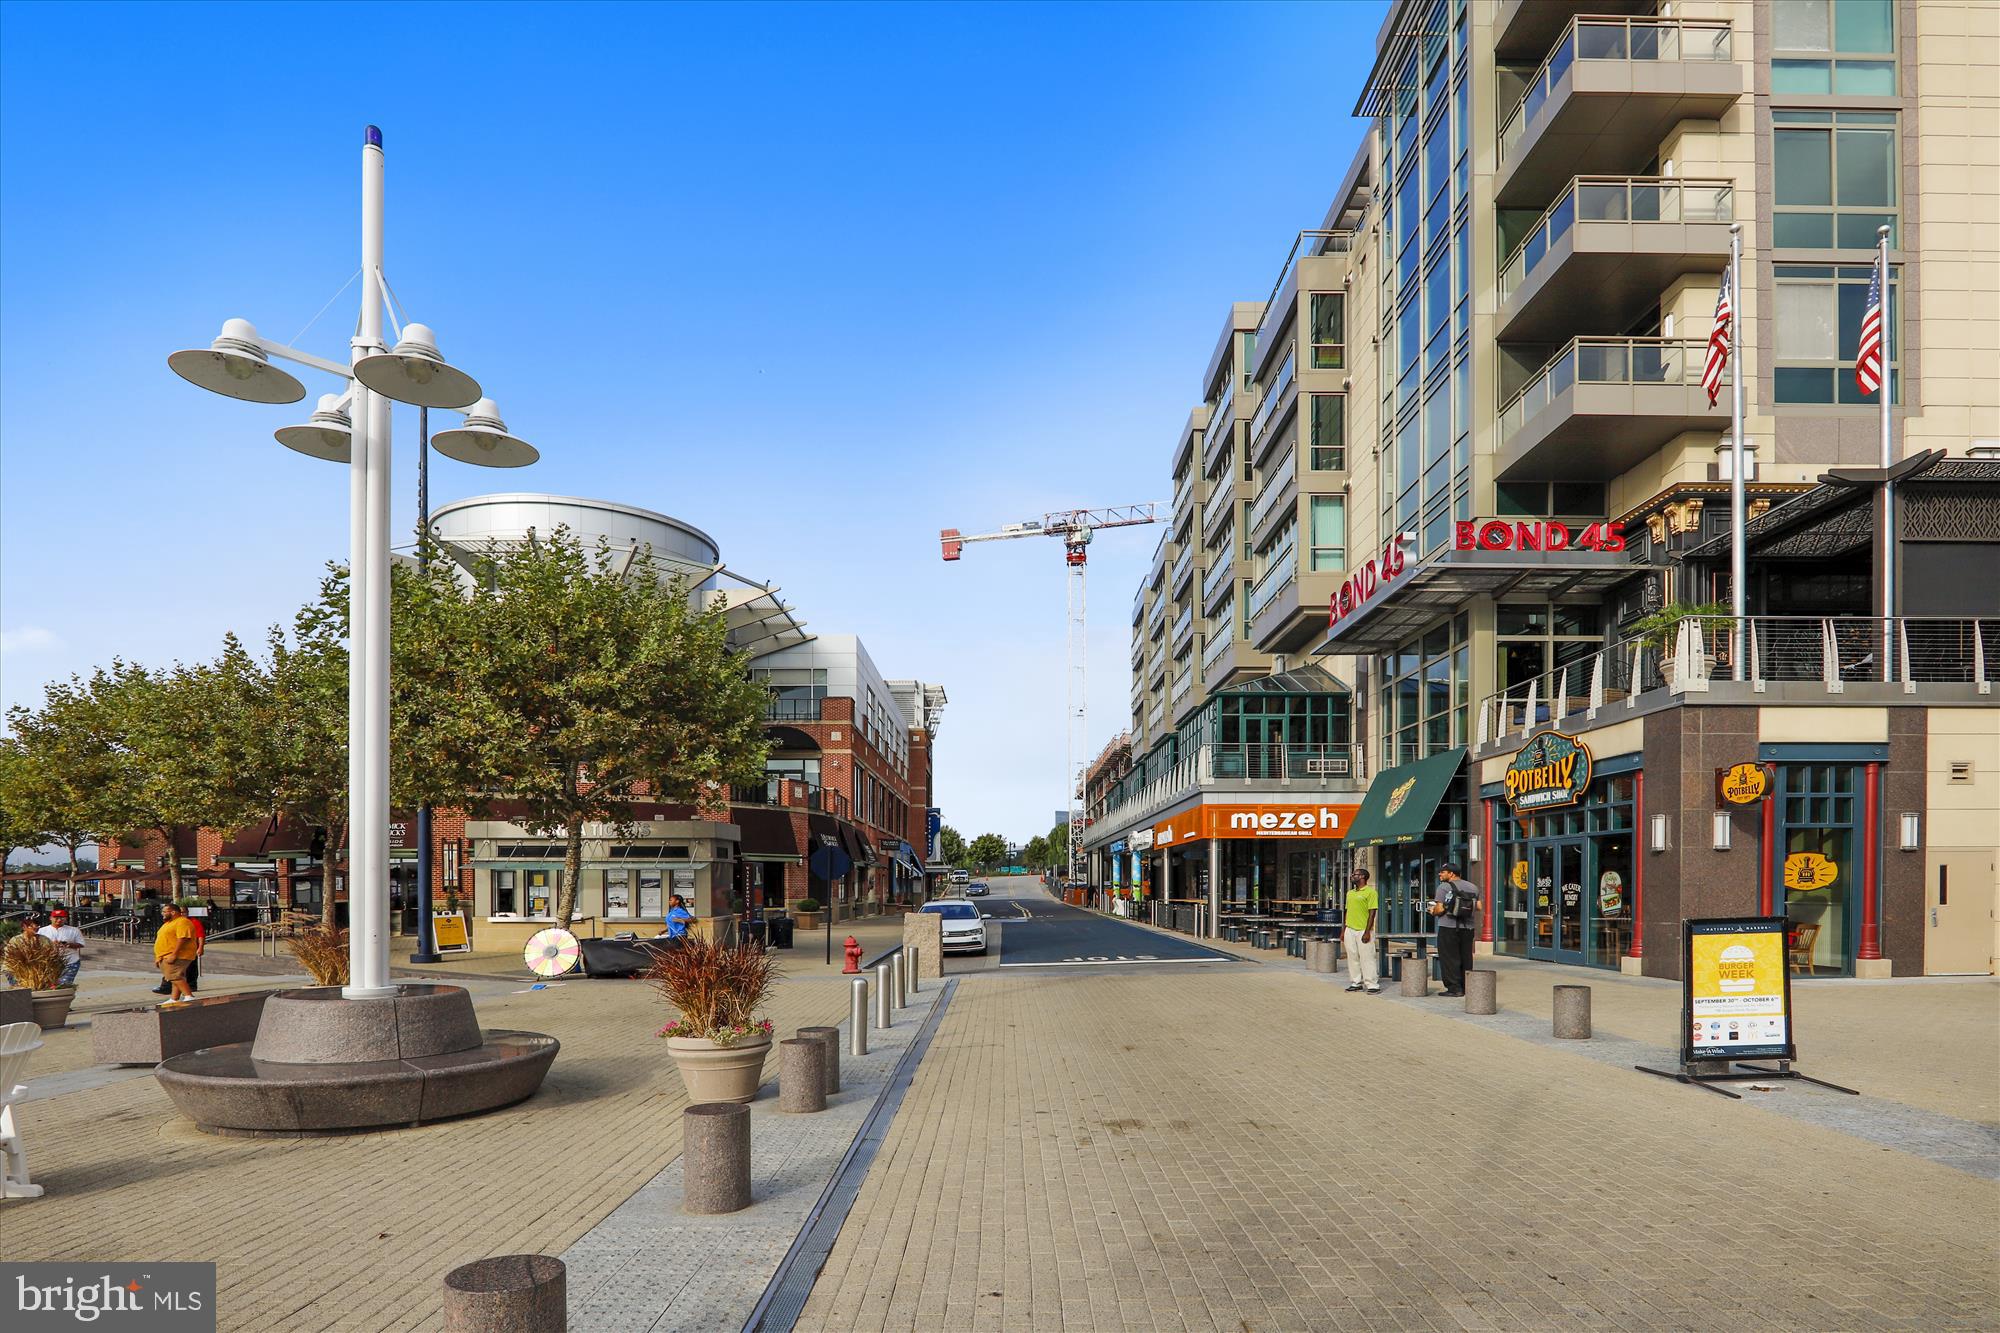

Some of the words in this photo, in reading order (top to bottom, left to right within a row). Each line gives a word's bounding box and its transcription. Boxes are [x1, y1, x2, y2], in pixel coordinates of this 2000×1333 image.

[1456, 520, 1570, 551] BOND
[1578, 522, 1626, 552] 45
[1329, 559, 1377, 628] BOND
[1381, 532, 1410, 583] 45
[1506, 752, 1576, 799] POTBELLY
[1520, 791, 1551, 805] SANDWICH
[1727, 782, 1760, 798] POTBELLY
[1231, 807, 1338, 829] mezeh
[1718, 962, 1754, 970] BURGER
[1718, 970, 1754, 979] WEEK
